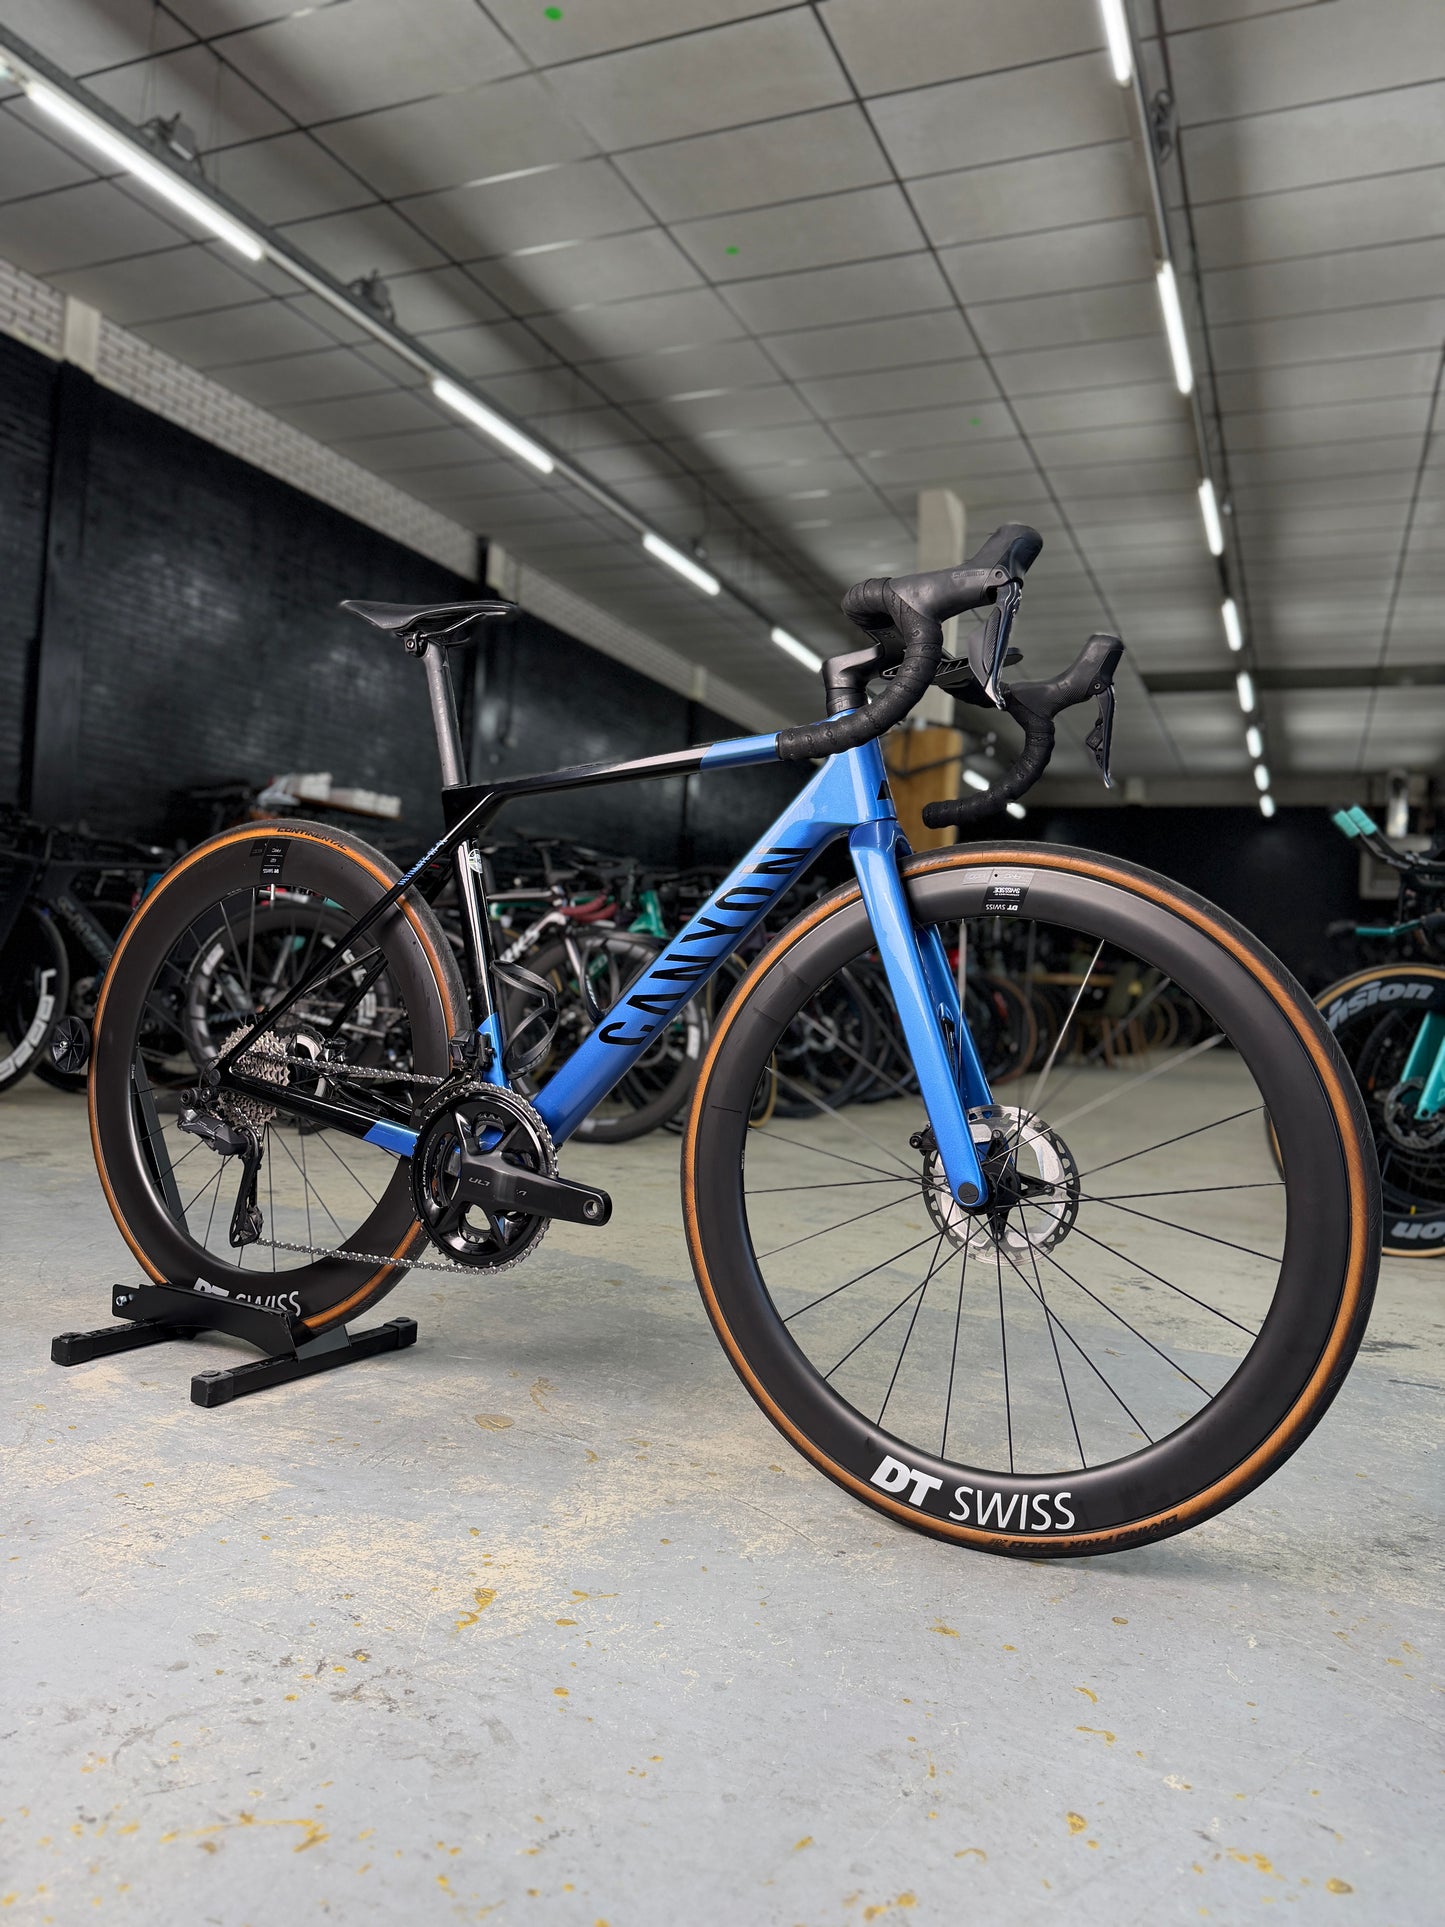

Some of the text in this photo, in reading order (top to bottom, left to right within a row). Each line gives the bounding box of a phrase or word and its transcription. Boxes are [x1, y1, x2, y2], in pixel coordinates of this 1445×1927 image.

[277, 827, 347, 851] CONTINENTAL
[598, 847, 813, 1046] CANYON
[236, 1290, 301, 1317] WISS
[869, 1455, 1076, 1532] DT SWISS
